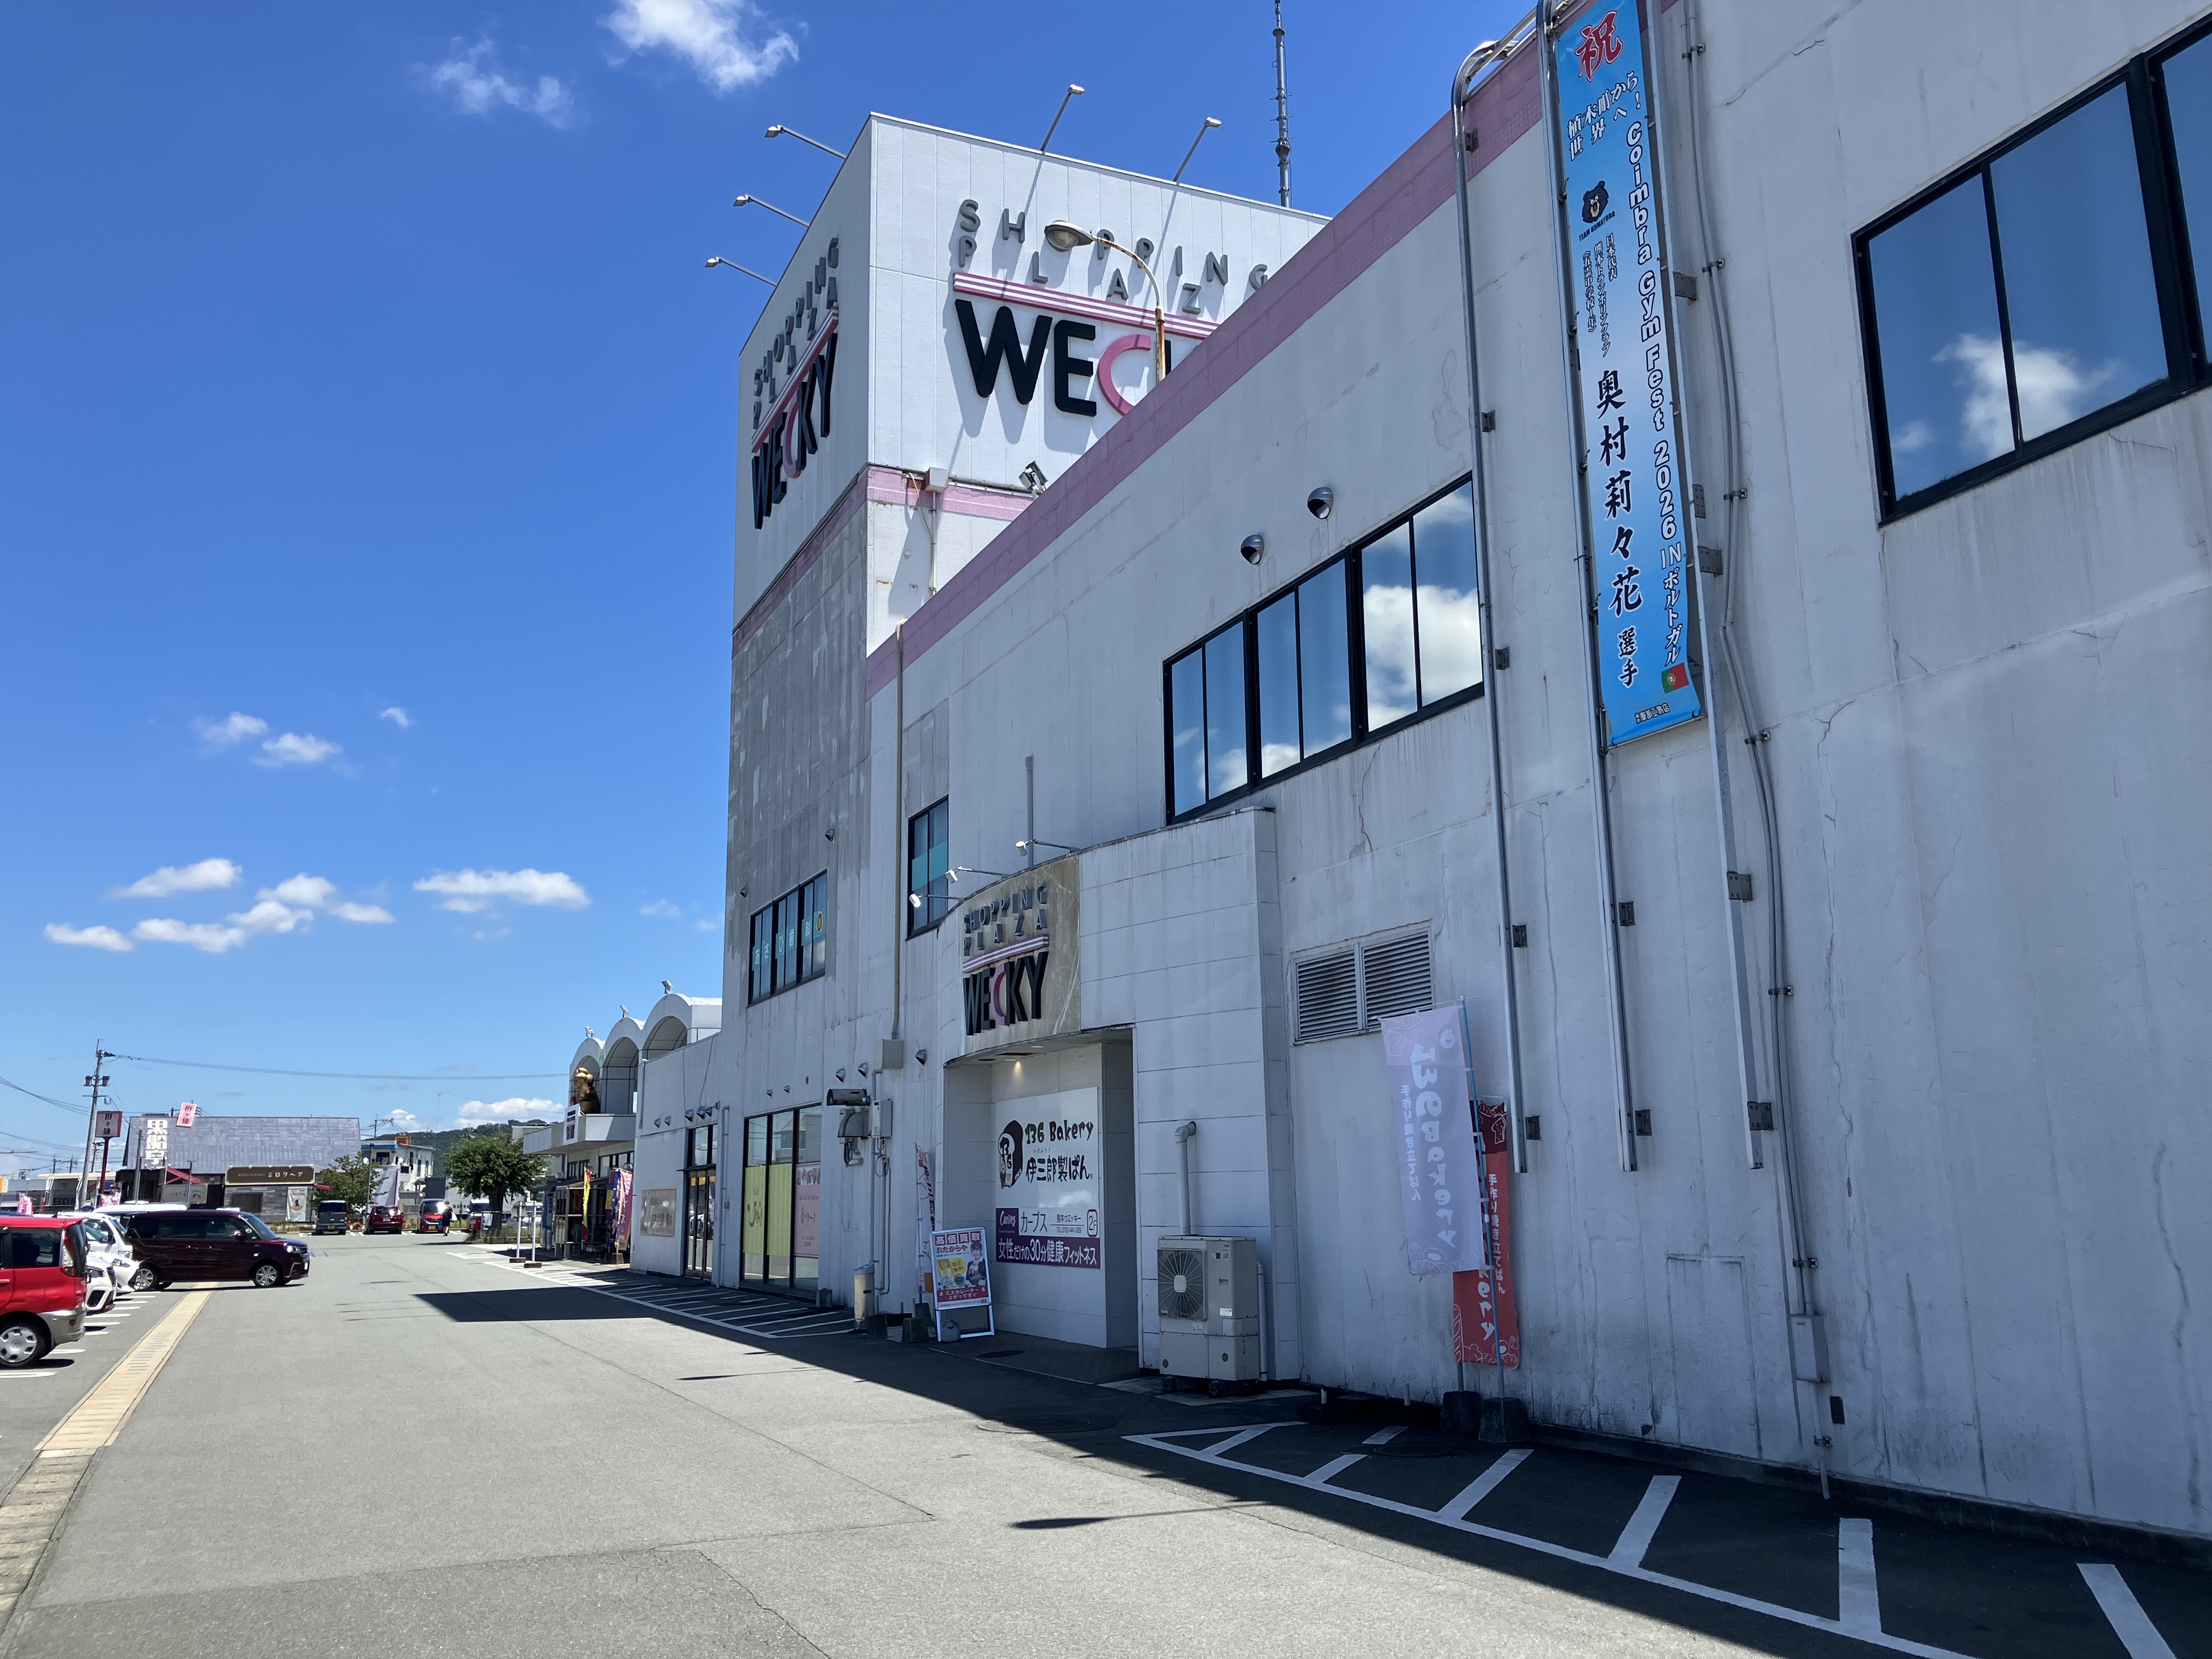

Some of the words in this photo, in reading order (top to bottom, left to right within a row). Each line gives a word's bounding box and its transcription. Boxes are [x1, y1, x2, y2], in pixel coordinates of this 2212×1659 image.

[1575, 10, 1624, 82] 祝
[1567, 70, 1639, 140] 植木町から
[1626, 121, 1652, 266] Coimbra
[960, 199, 1268, 291] SHPPING
[1579, 228, 1590, 242] TEAM
[1606, 232, 1618, 282] 日本代表
[753, 237, 839, 397] SHOPPING
[1593, 241, 1611, 358] 熊本トランポリンクラブ
[1638, 269, 1661, 342] Gym
[753, 276, 838, 430] PLAZA
[954, 298, 1172, 418] WEC
[1646, 343, 1664, 432] Fest
[751, 331, 839, 531] WECKY
[1596, 369, 1643, 617] 奥村莉々花
[1653, 439, 1677, 540] 2026
[1660, 541, 1683, 570] IN
[1663, 566, 1683, 668] ポルトガル
[1617, 626, 1638, 689] 選手
[963, 909, 1048, 957] PLAZA
[964, 884, 1047, 934] SHOPPING
[963, 951, 1049, 1036] WECKY
[1025, 1122, 1045, 1144] 136
[1049, 1120, 1094, 1142] Bakery
[936, 1244, 968, 1254] おたからや
[998, 1237, 1097, 1265] 女性だけの30分健康フィットネス
[1020, 1211, 1047, 1233] カーブス
[1088, 1215, 1097, 1231] 2F
[1488, 1173, 1506, 1295] 手作り焼き立てぱん
[945, 1287, 980, 1295] エスカレーター
[948, 1292, 978, 1301] 上がってすぐ
